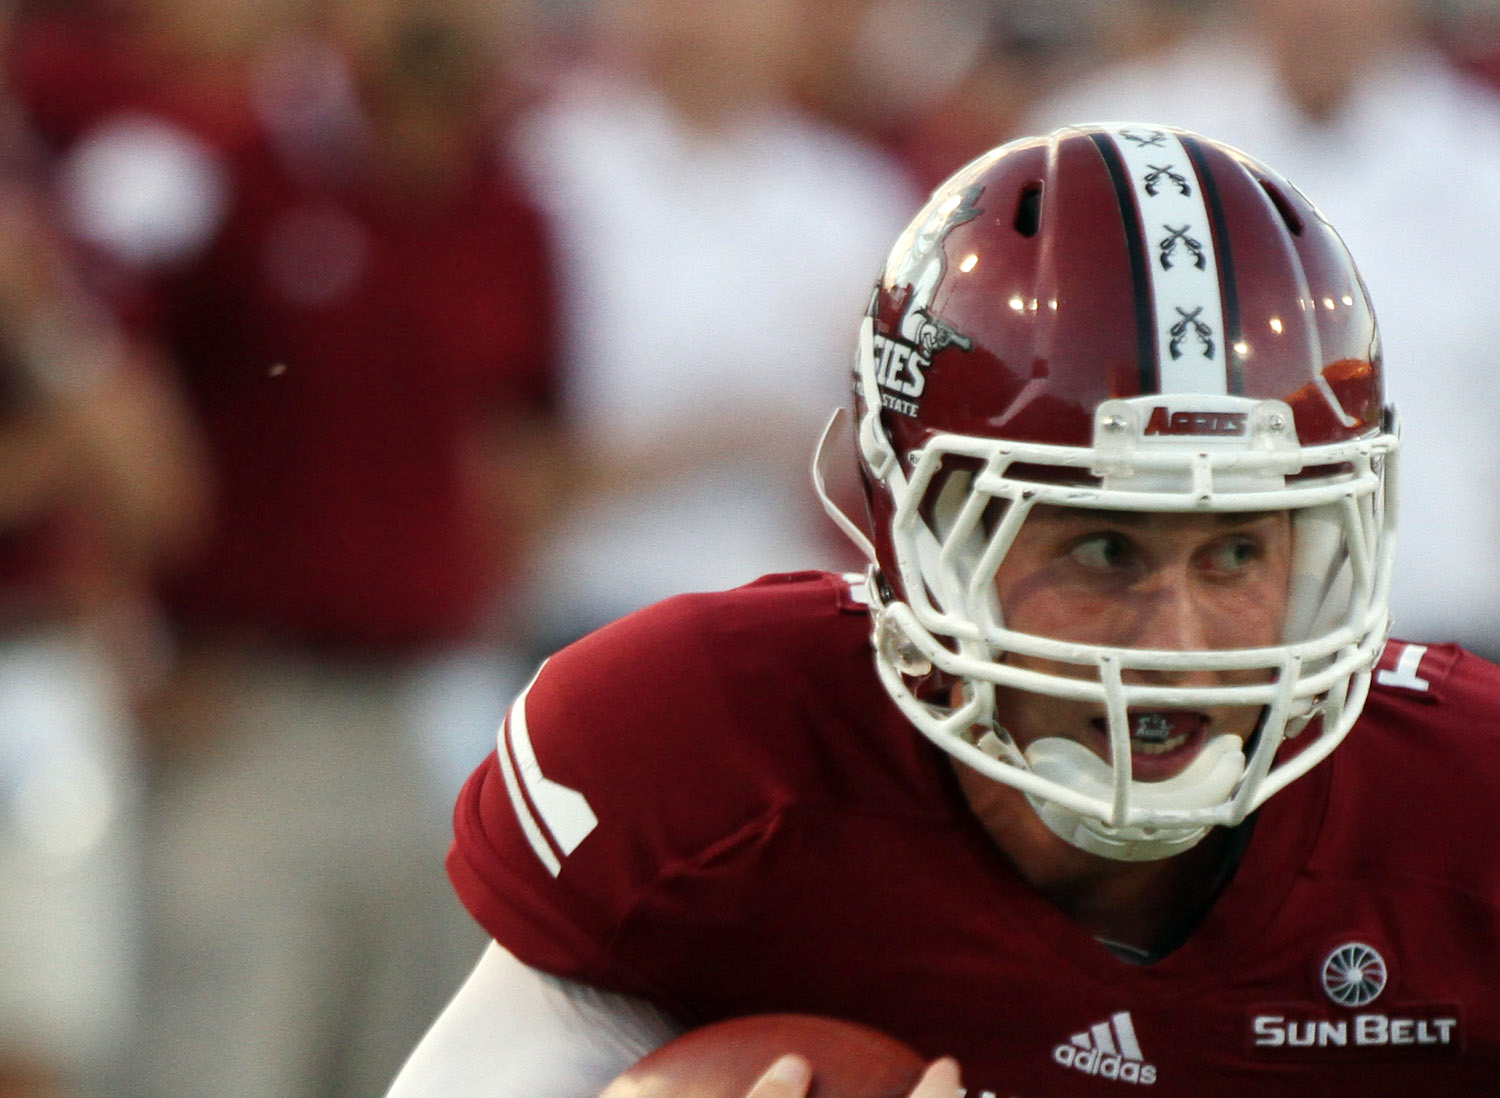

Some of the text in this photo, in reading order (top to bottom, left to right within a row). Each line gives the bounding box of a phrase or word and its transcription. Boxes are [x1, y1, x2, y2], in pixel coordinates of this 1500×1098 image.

[882, 393, 919, 418] STATE
[1254, 1015, 1456, 1046] SUN BELT
[1054, 1043, 1157, 1085] adidas
